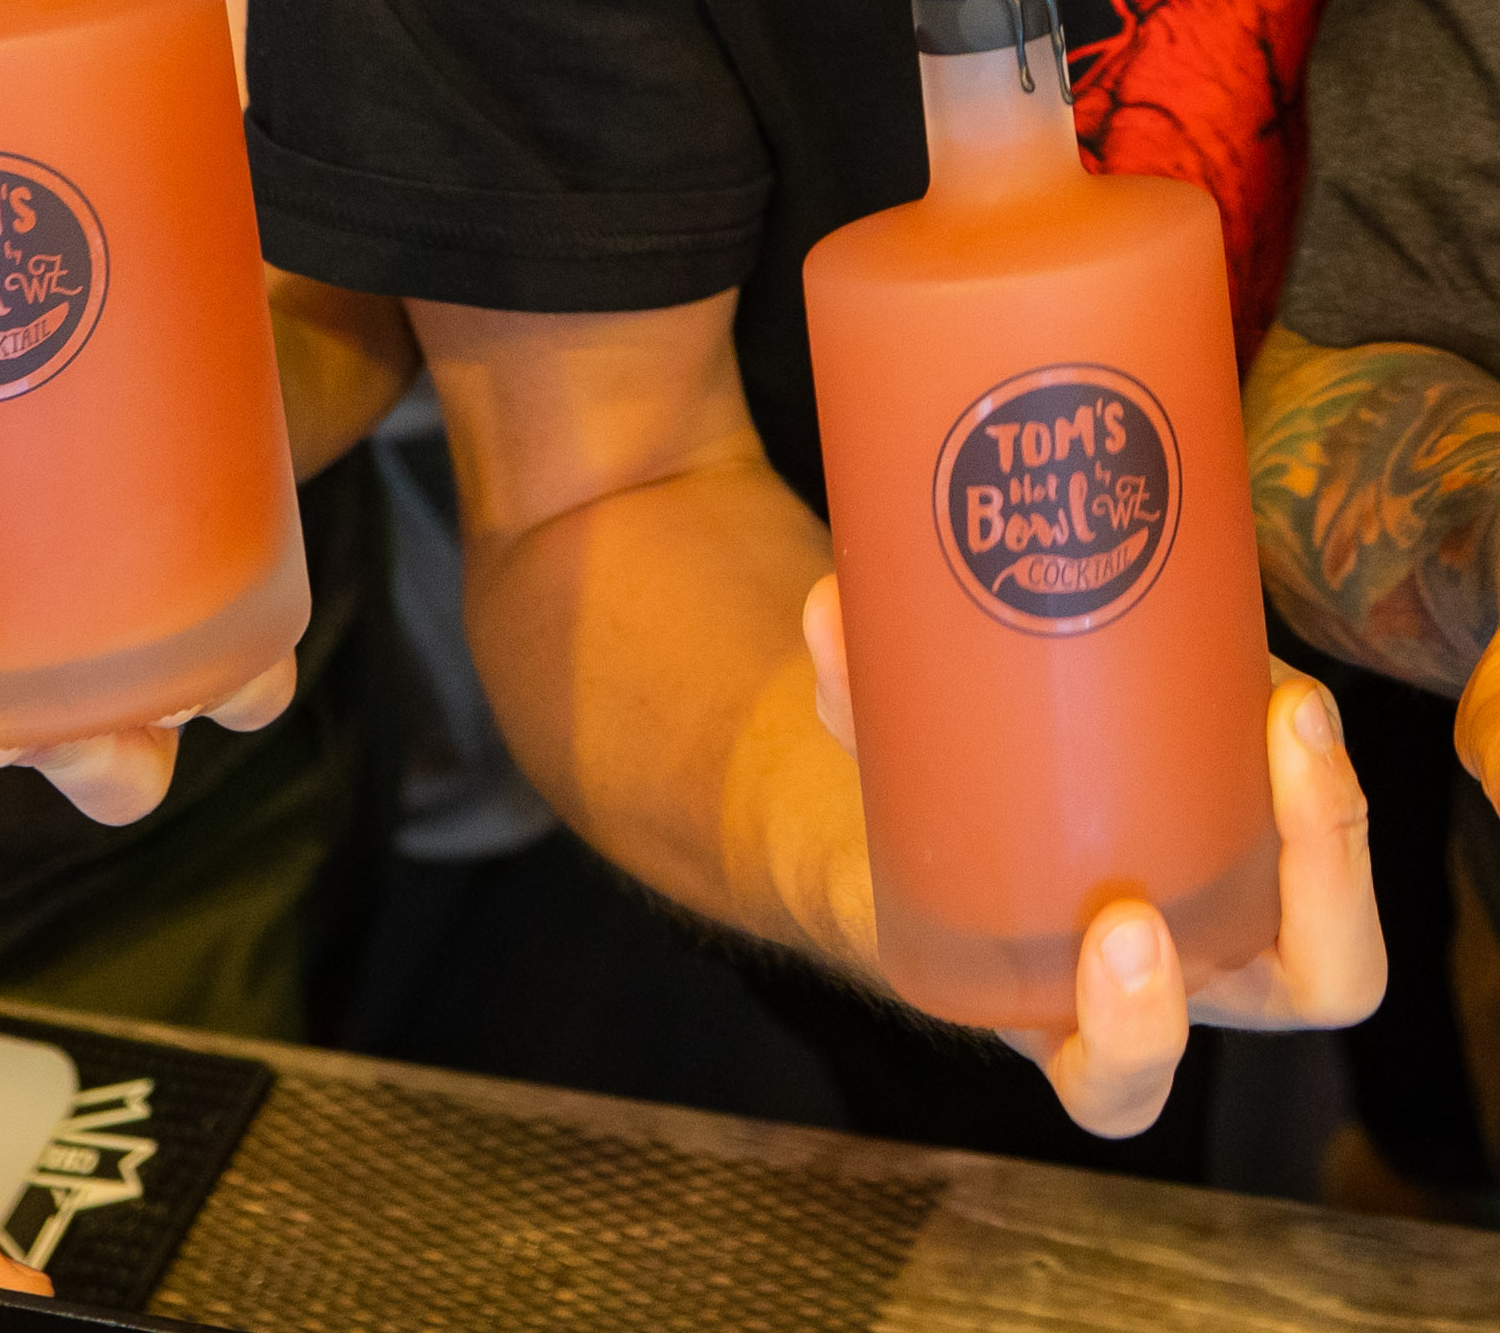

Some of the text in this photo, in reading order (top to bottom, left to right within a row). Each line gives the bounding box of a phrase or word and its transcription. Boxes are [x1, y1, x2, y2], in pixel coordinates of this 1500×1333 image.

[985, 397, 1126, 474] TOM'S
[966, 471, 1096, 554] Bowl
[1028, 546, 1132, 590] COCKTAIL
